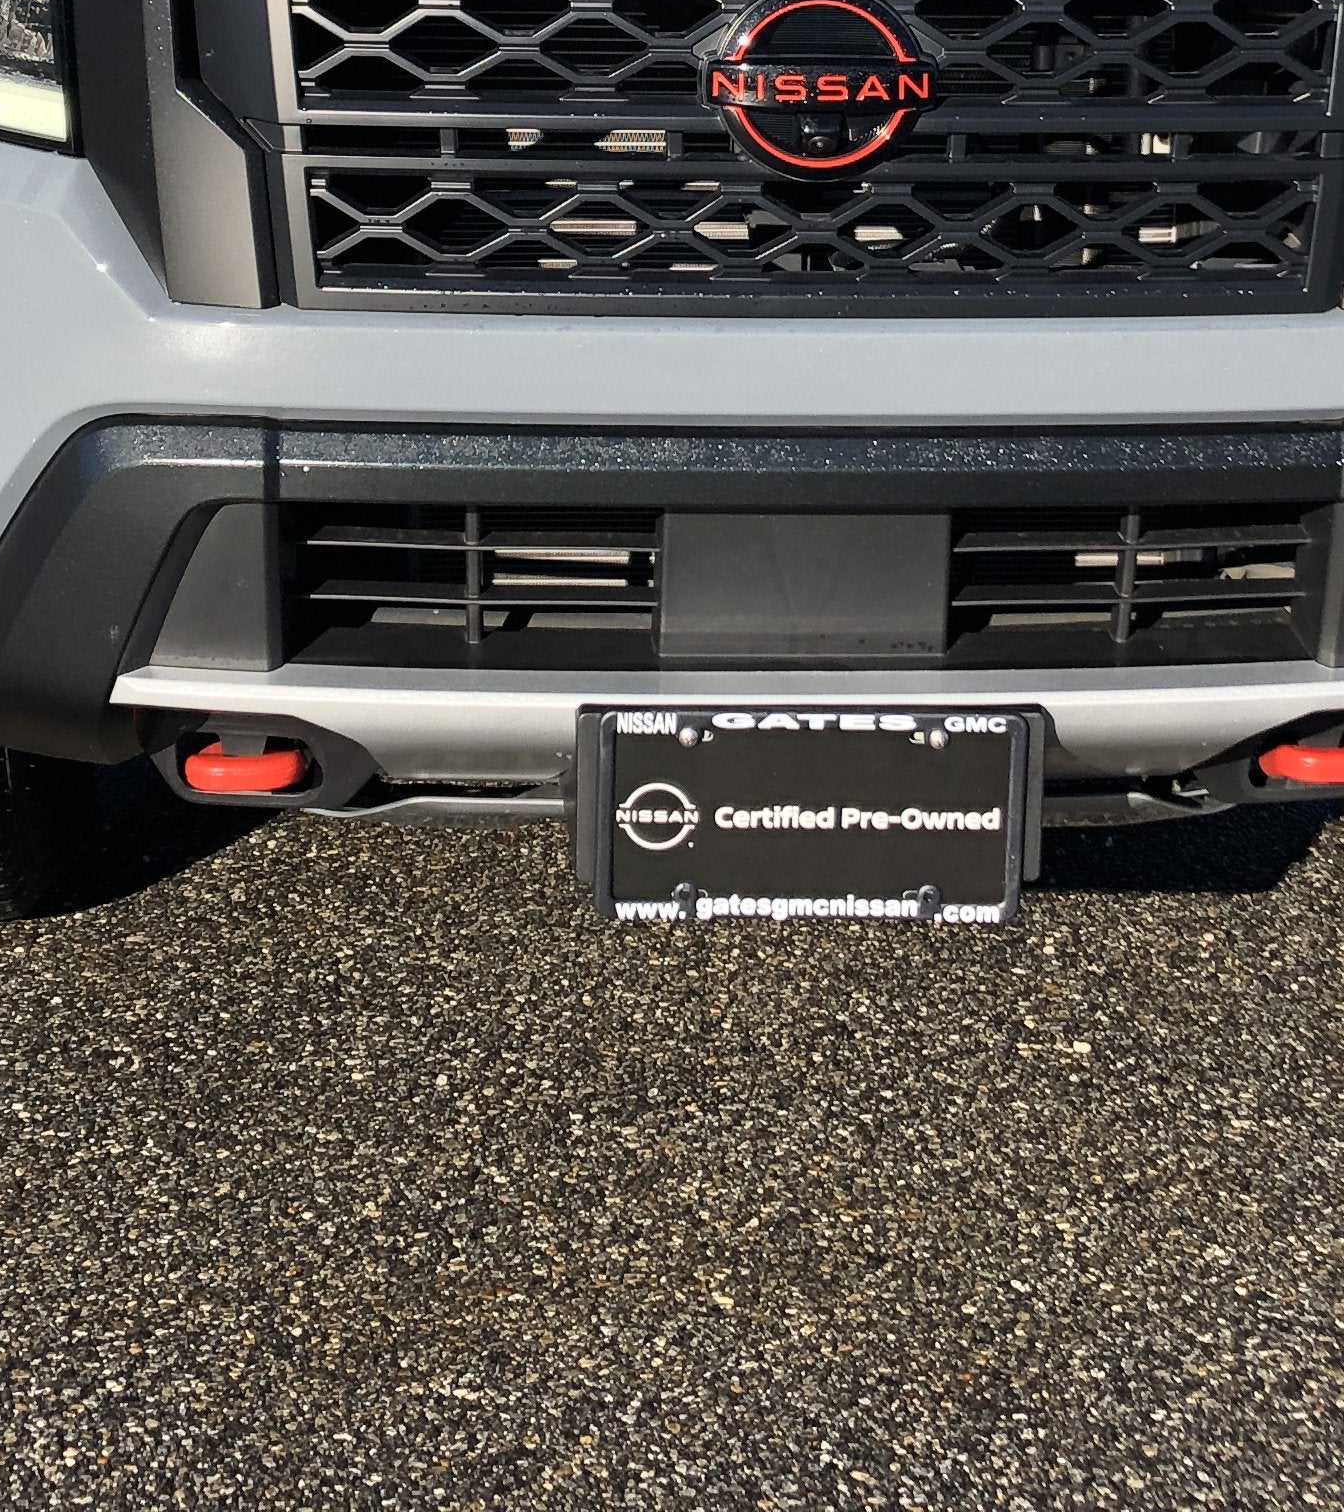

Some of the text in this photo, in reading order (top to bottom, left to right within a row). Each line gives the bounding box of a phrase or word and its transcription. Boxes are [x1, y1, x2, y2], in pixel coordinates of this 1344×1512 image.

[711, 71, 929, 101] NISSAN
[617, 712, 1008, 735] NISSAN GATES GMC
[616, 806, 1001, 830] NISSAN Certified Pre-Owned
